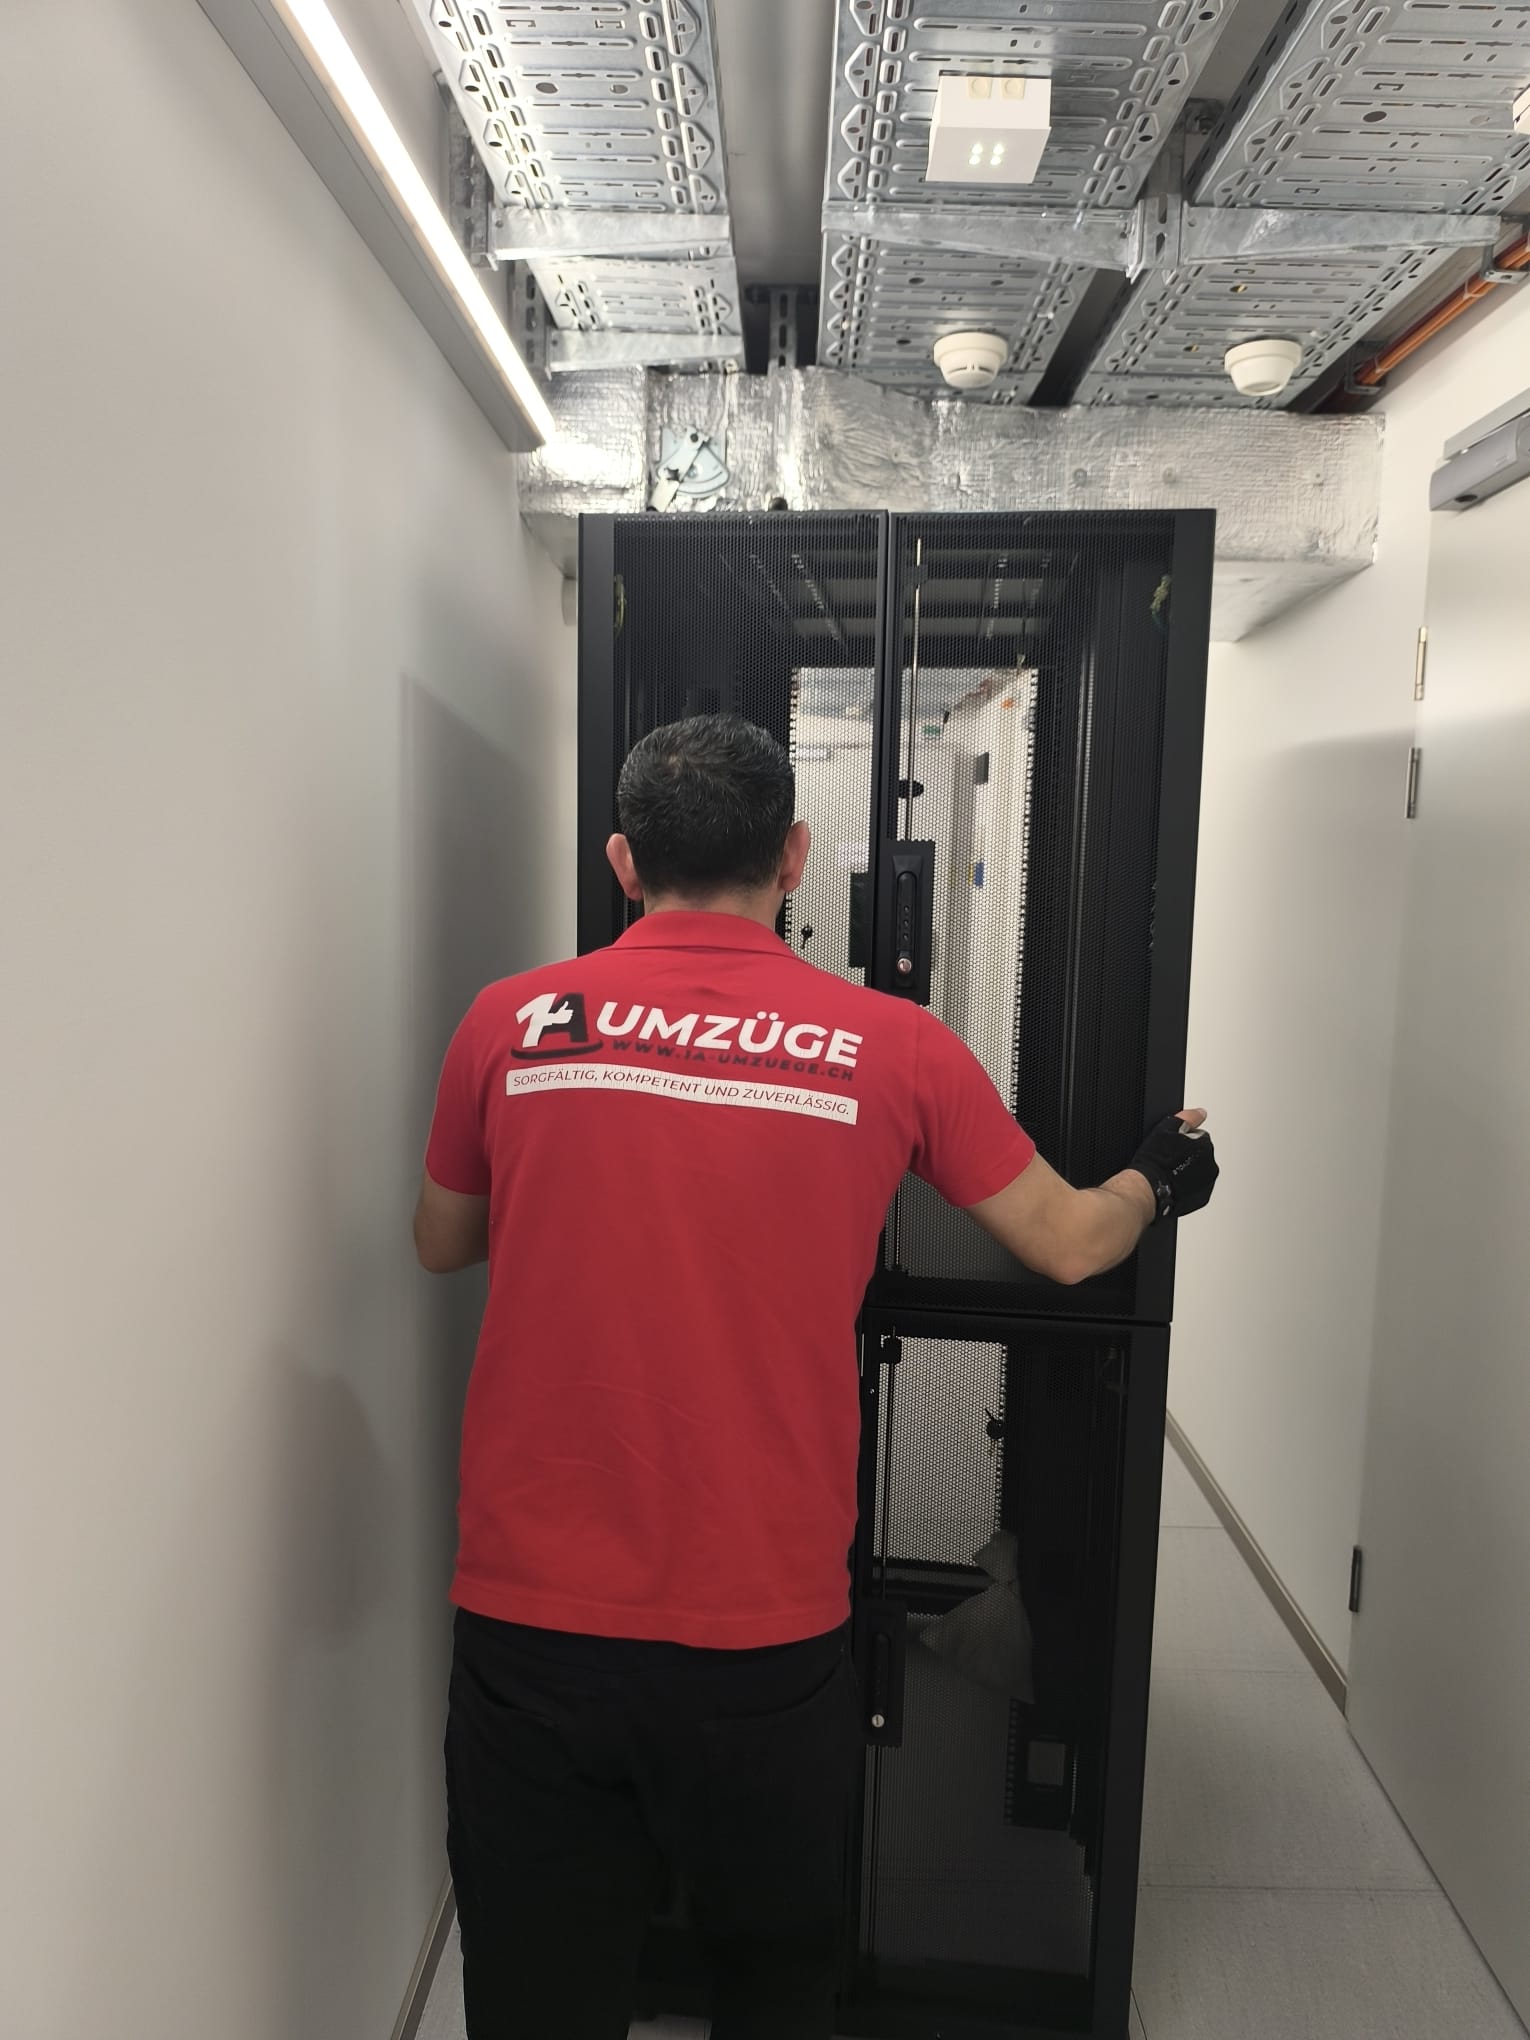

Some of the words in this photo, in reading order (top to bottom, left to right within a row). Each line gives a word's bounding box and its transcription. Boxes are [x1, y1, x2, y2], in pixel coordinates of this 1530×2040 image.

[596, 1001, 864, 1068] UMZÜGE
[612, 1038, 854, 1082] WWW.1A-UMZUEGE.CH
[513, 1069, 598, 1088] SORGFÄLTIG,
[602, 1069, 702, 1095] KOMPETENT
[704, 1085, 740, 1099] UND
[742, 1087, 850, 1116] ZUVERLÄSSIG.
